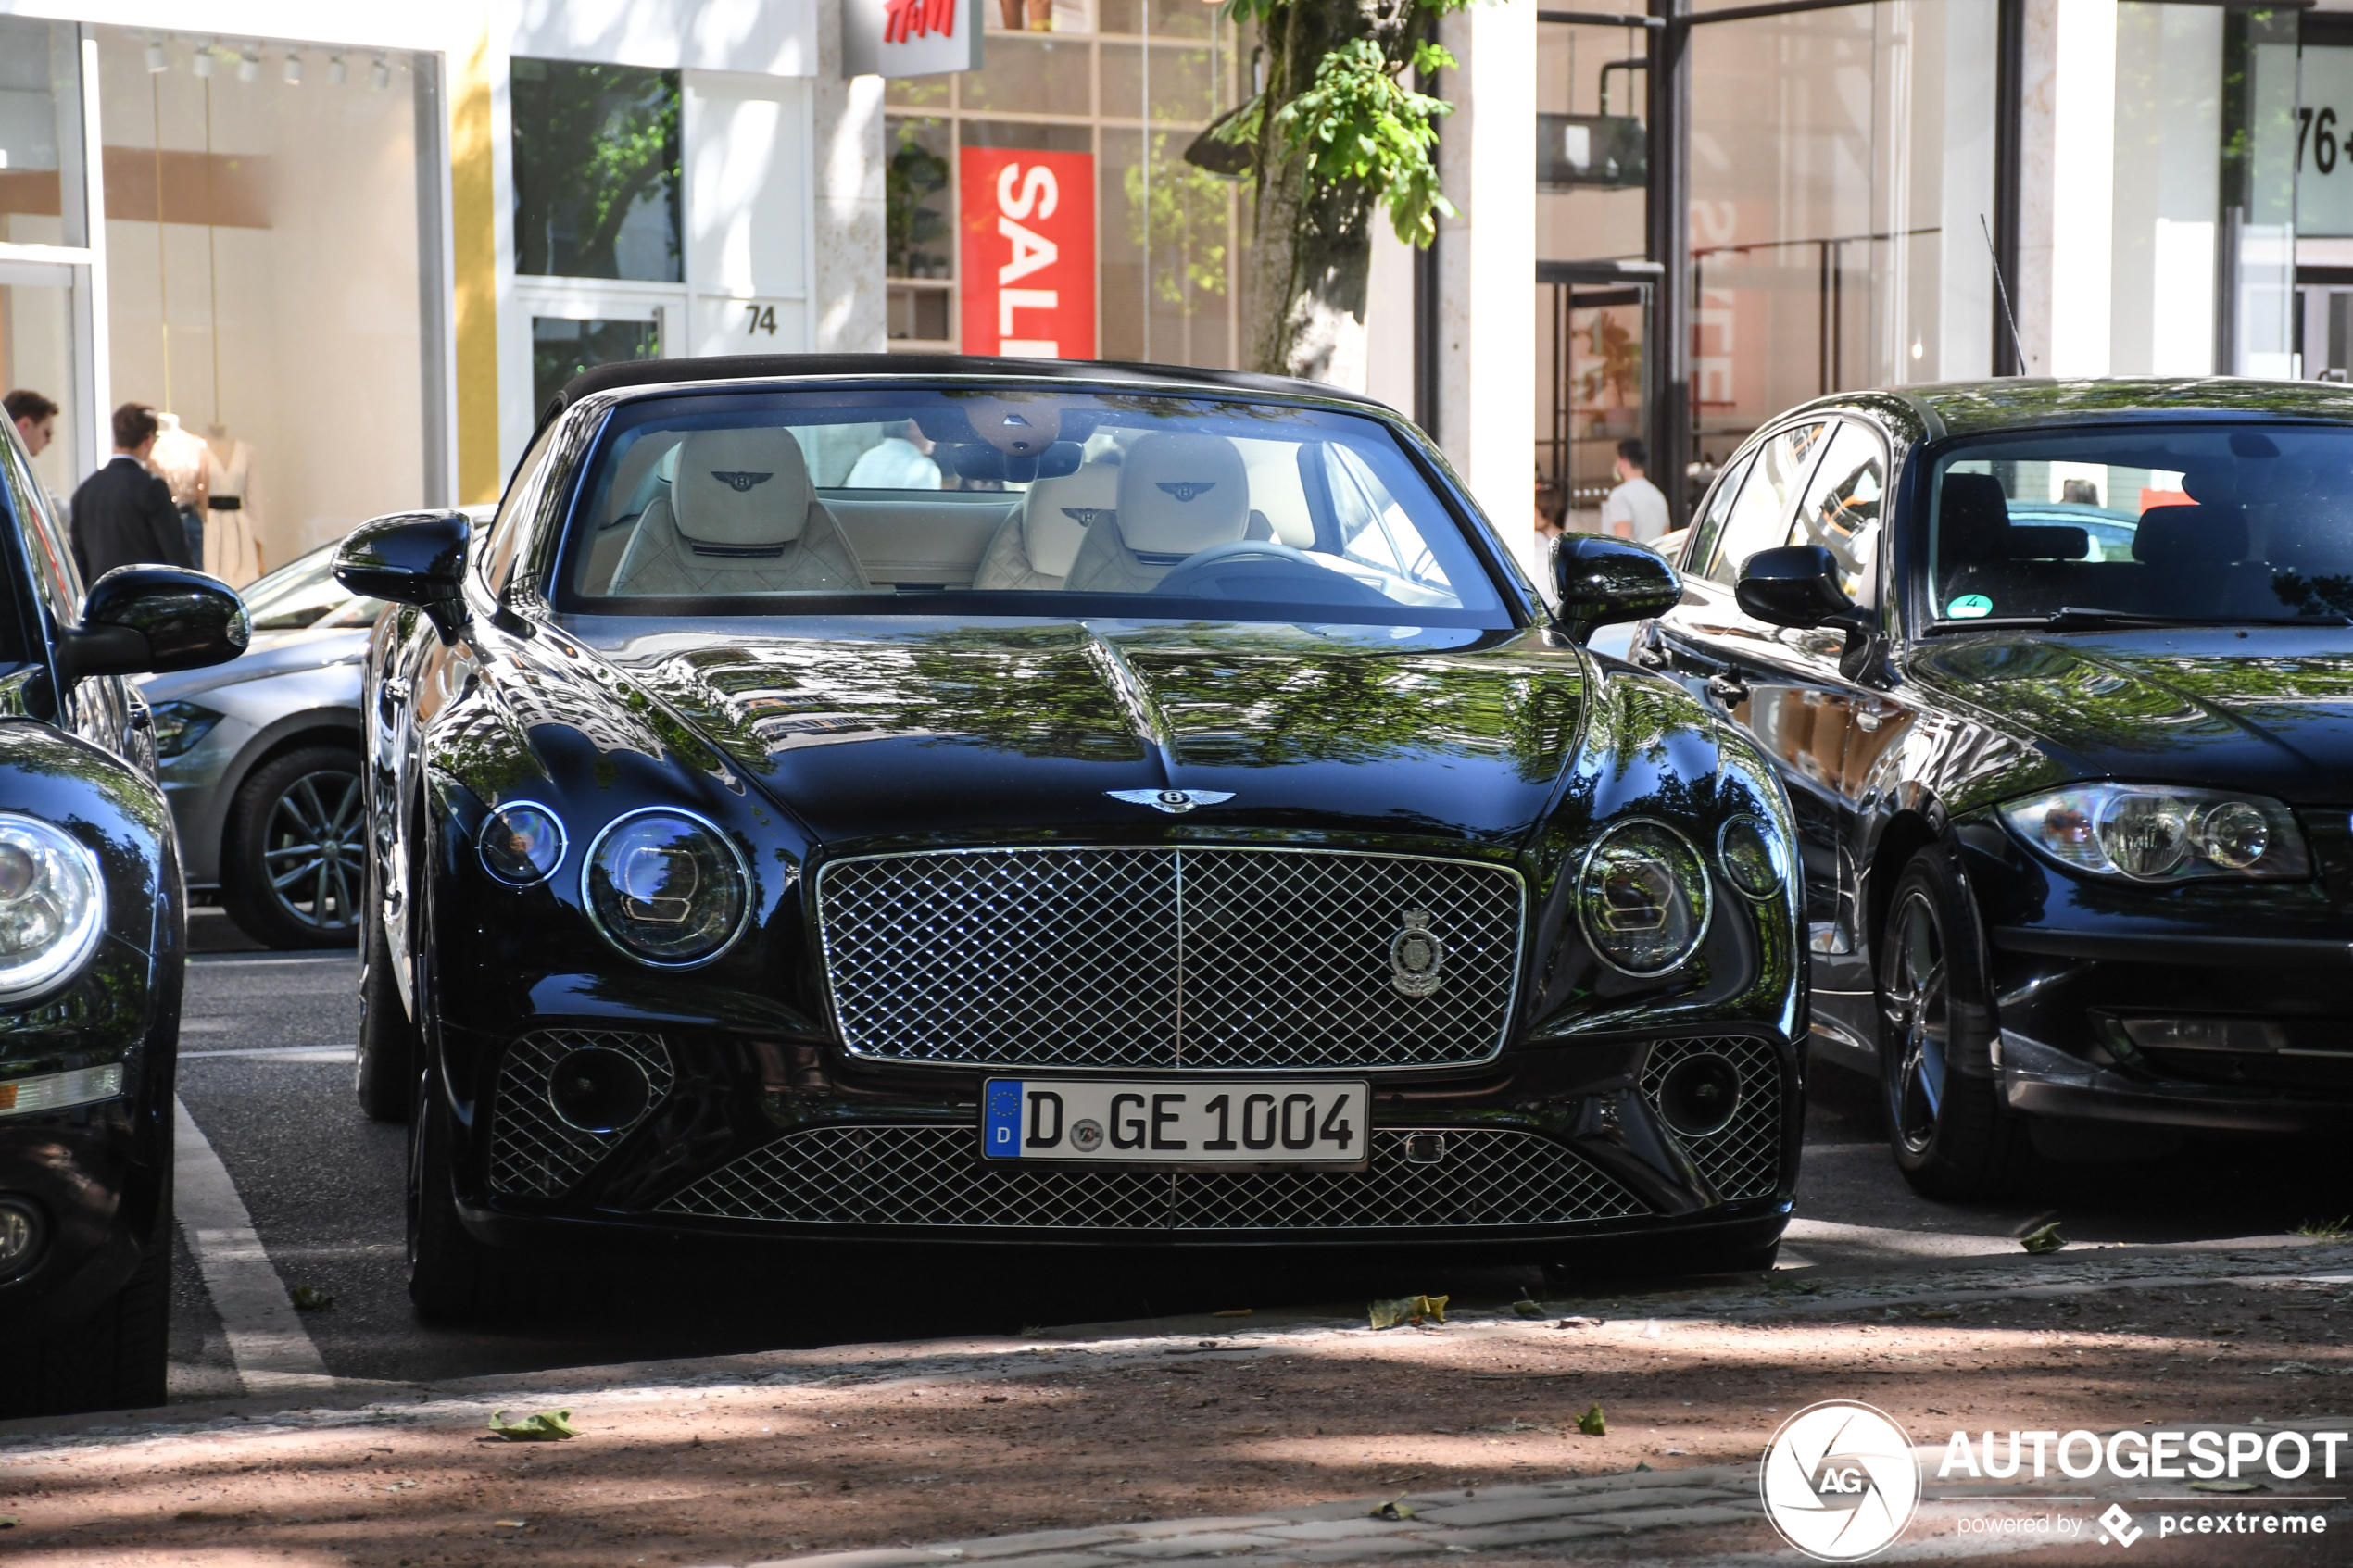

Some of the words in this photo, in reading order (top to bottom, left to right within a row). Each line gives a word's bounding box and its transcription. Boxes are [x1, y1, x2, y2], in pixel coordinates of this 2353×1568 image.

[745, 304, 778, 336] 74
[1965, 596, 1978, 608] 4
[1026, 1091, 1063, 1148] D
[1110, 1093, 1187, 1150] GE
[1202, 1092, 1353, 1151] 1004
[997, 1126, 1011, 1144] D
